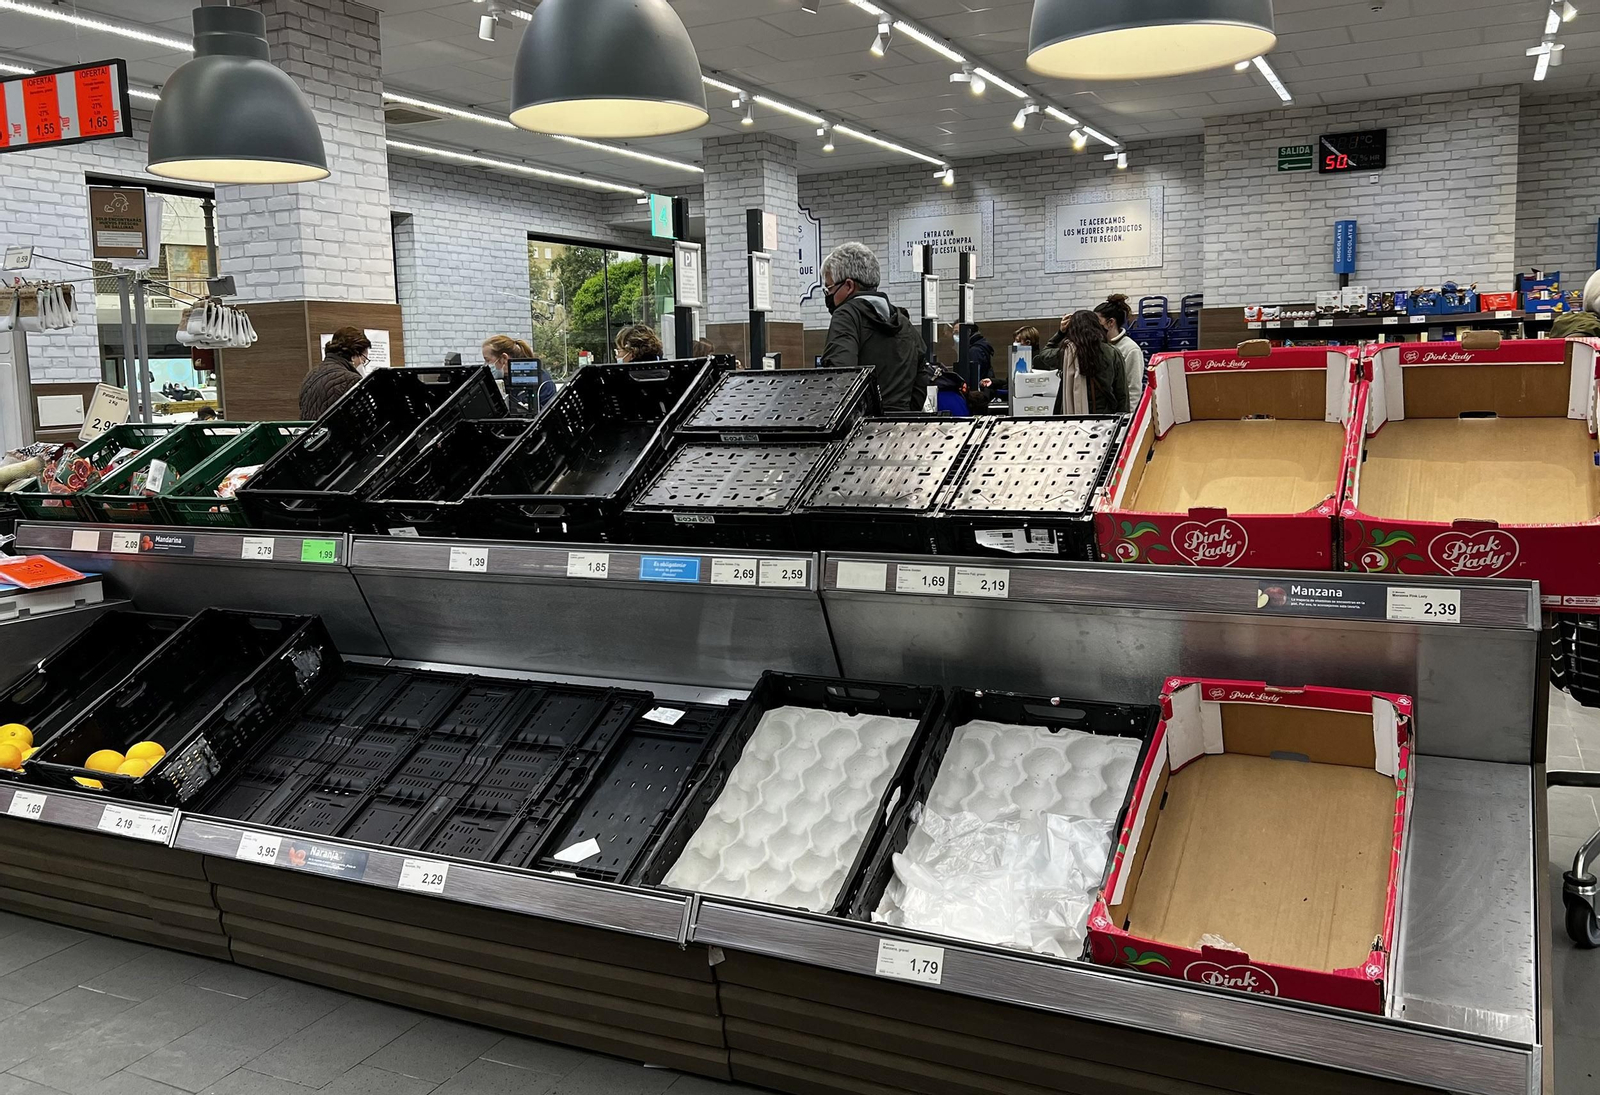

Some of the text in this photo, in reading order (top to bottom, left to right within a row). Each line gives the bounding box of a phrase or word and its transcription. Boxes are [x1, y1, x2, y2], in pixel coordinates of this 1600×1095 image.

[89, 116, 108, 129] 1,65
[36, 123, 54, 136] 1,55
[1281, 146, 1310, 155] SALIDA
[659, 205, 668, 229] 4
[1089, 216, 1125, 226] ACERCAMOS
[1077, 227, 1104, 235] MEJORES
[1106, 224, 1142, 233] PRODUCTOS
[1423, 352, 1473, 362] Pink Lady
[1205, 360, 1248, 369] Pink Lady
[1184, 524, 1232, 550] Pink
[125, 541, 138, 549] 2,09
[1192, 540, 1237, 561] Lady
[1442, 535, 1501, 560] Pink
[257, 547, 271, 556] 2,79
[319, 550, 332, 559] 1,99
[469, 558, 484, 567] 1,39
[1450, 551, 1505, 572] Lady
[588, 562, 606, 573] 1,85
[734, 569, 754, 580] 2,69
[782, 570, 803, 581] 2,59
[922, 576, 945, 587] 1,69
[981, 580, 1005, 591] 2,19
[1291, 585, 1343, 597] Manzana
[1424, 603, 1456, 617] 2,39
[1228, 690, 1255, 699] Pink
[1255, 693, 1281, 702] Lady
[26, 803, 41, 814] 1,69
[116, 818, 133, 829] 2,19
[151, 824, 168, 835] 1,45
[257, 845, 276, 858] 3,95
[310, 846, 340, 861] Naranja
[422, 873, 443, 886] 2,29
[910, 958, 938, 974] 1,79
[1201, 971, 1259, 986] Pink
